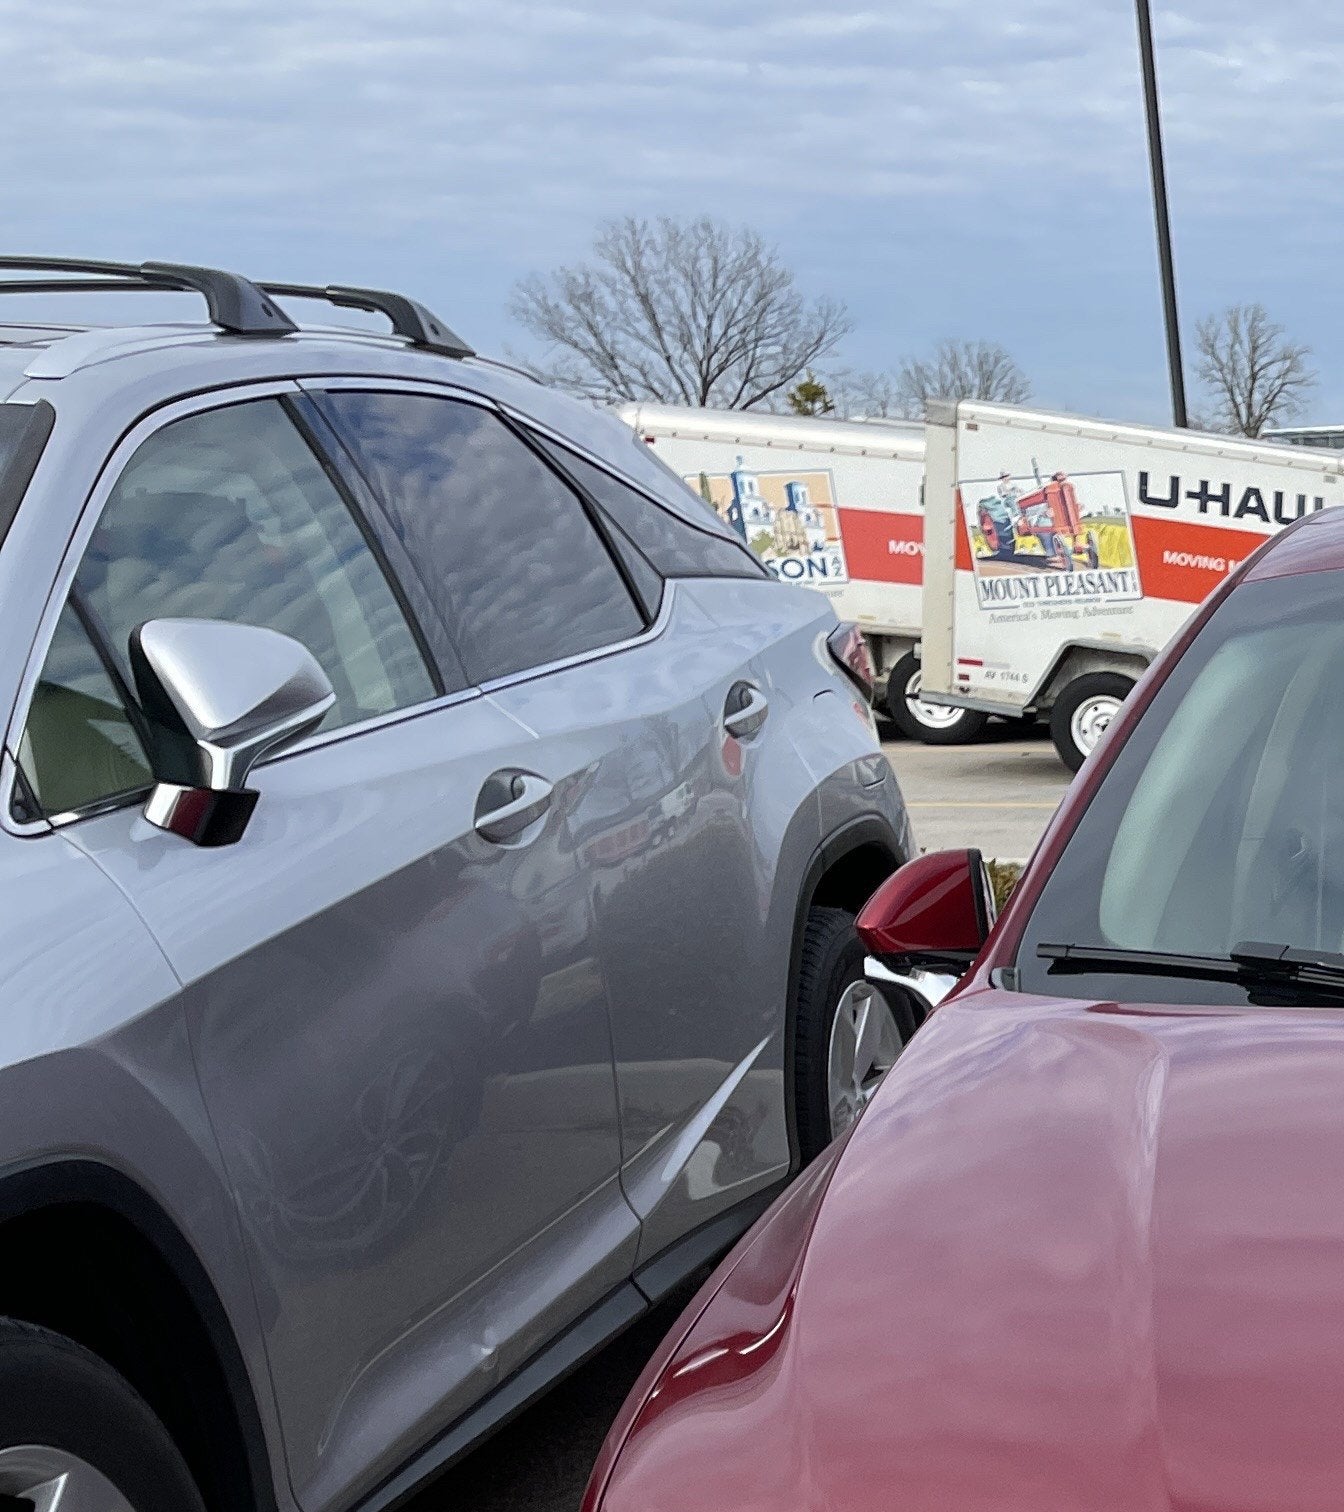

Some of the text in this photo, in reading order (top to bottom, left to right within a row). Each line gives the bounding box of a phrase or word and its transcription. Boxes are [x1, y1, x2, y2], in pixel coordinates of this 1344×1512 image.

[1163, 550, 1225, 572] MOVING
[980, 571, 1129, 601] MOUNT PLEASANT
[989, 605, 1134, 624] America's Moving Adventure
